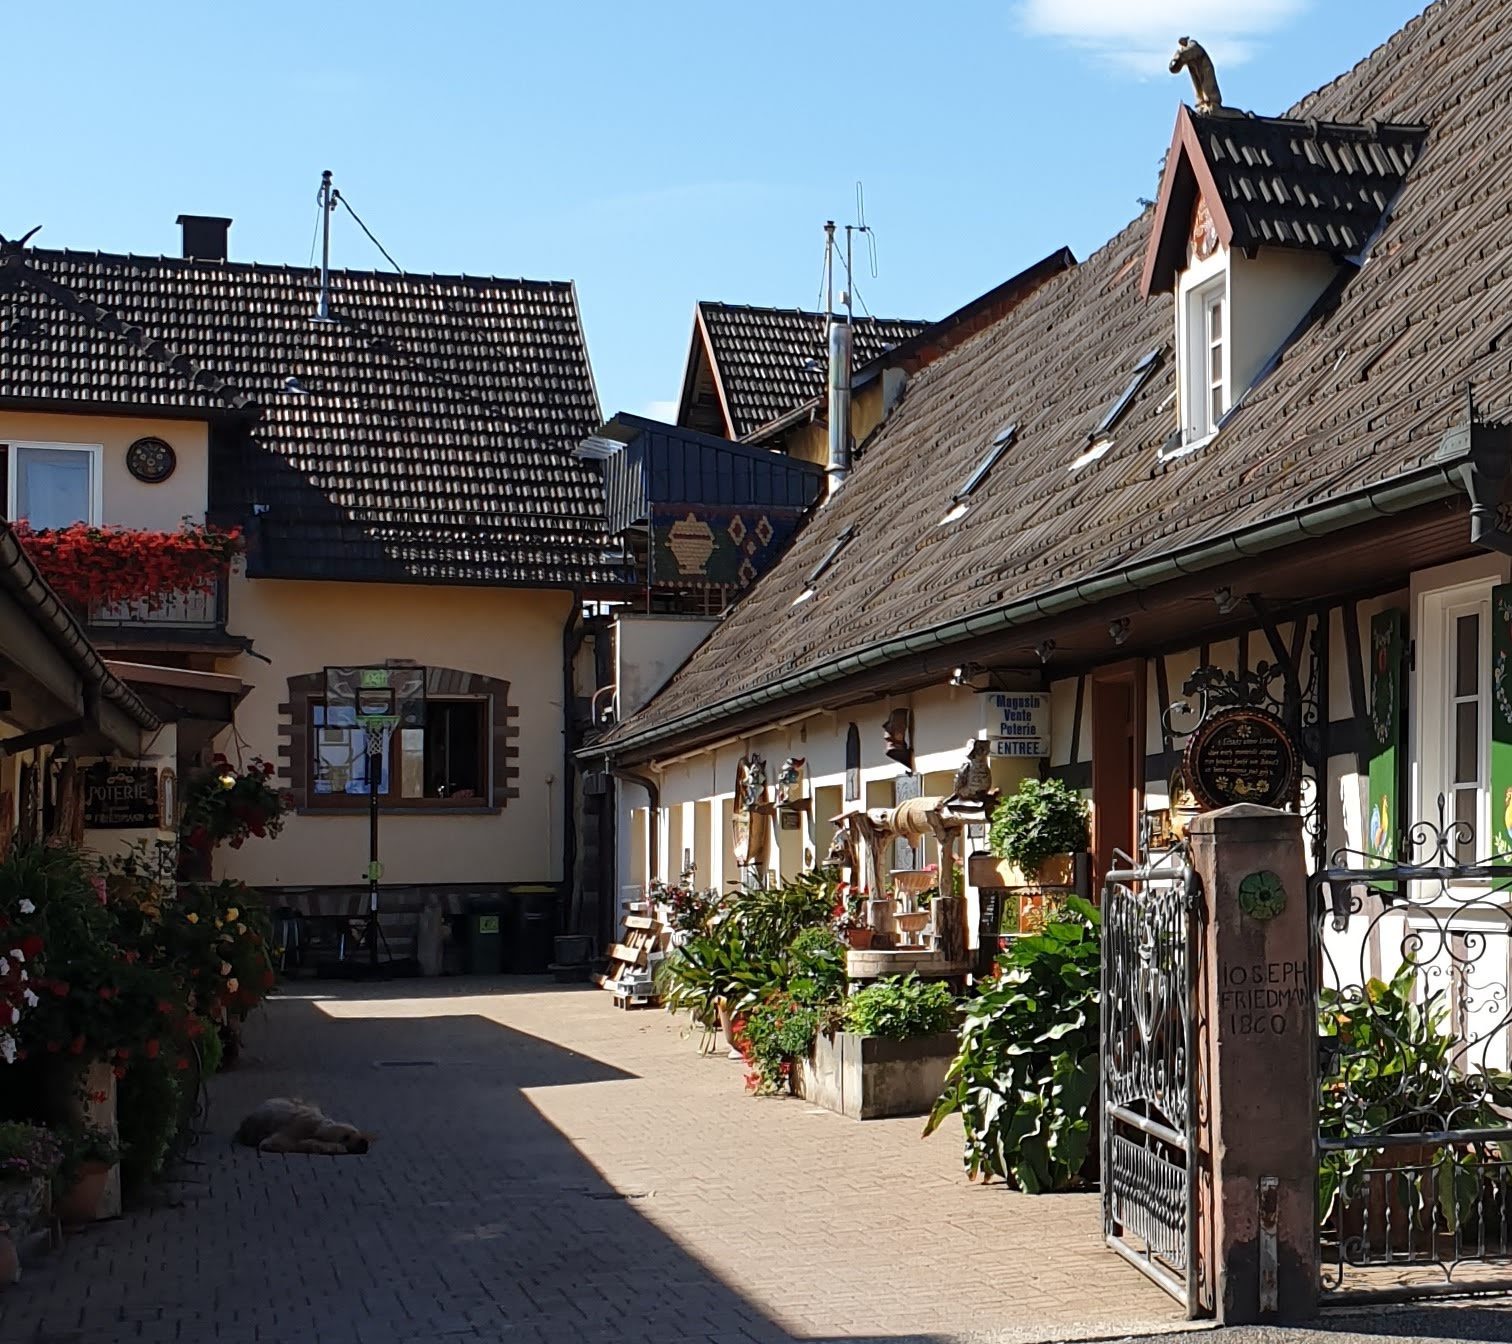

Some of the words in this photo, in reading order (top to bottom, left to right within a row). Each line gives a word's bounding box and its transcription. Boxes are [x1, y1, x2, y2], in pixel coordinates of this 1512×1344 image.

[996, 695, 1040, 710] Magasin
[1004, 709, 1032, 722] Vente
[1000, 723, 1036, 735] Poterie
[997, 741, 1040, 755] ENTREE
[87, 784, 148, 806] POTERIE
